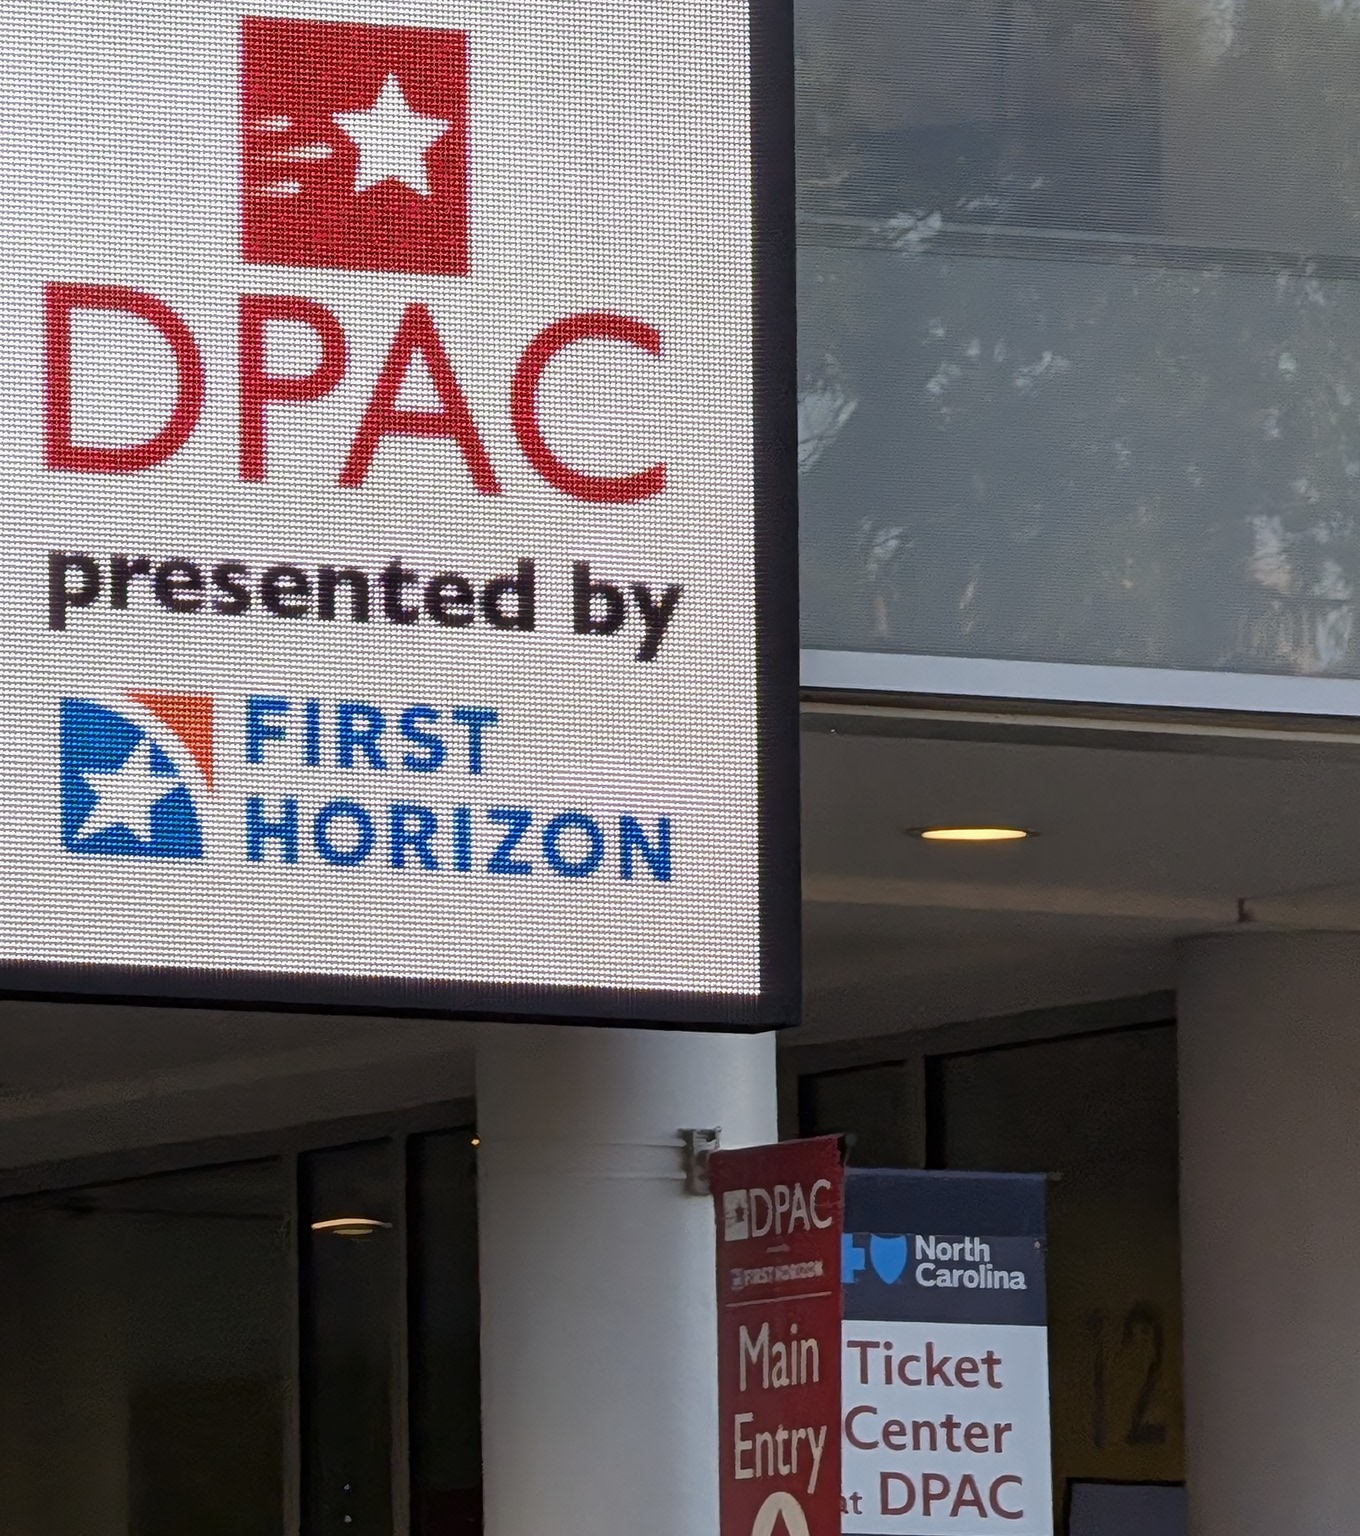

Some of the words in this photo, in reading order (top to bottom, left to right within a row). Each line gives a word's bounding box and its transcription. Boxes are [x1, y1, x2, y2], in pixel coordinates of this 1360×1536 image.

[42, 281, 668, 504] DPAC
[47, 549, 536, 632] presented
[574, 561, 681, 663] by
[245, 693, 500, 776] FIRST
[244, 795, 673, 883] HORIZON
[750, 1178, 833, 1238] DPAC
[915, 1235, 990, 1262] North
[915, 1263, 1027, 1290] Carolina
[739, 1322, 820, 1392] Main
[847, 1340, 1003, 1389] Ticket
[734, 1412, 827, 1495] Entry
[844, 1405, 1012, 1453] Center
[880, 1471, 1024, 1520] DPAC
